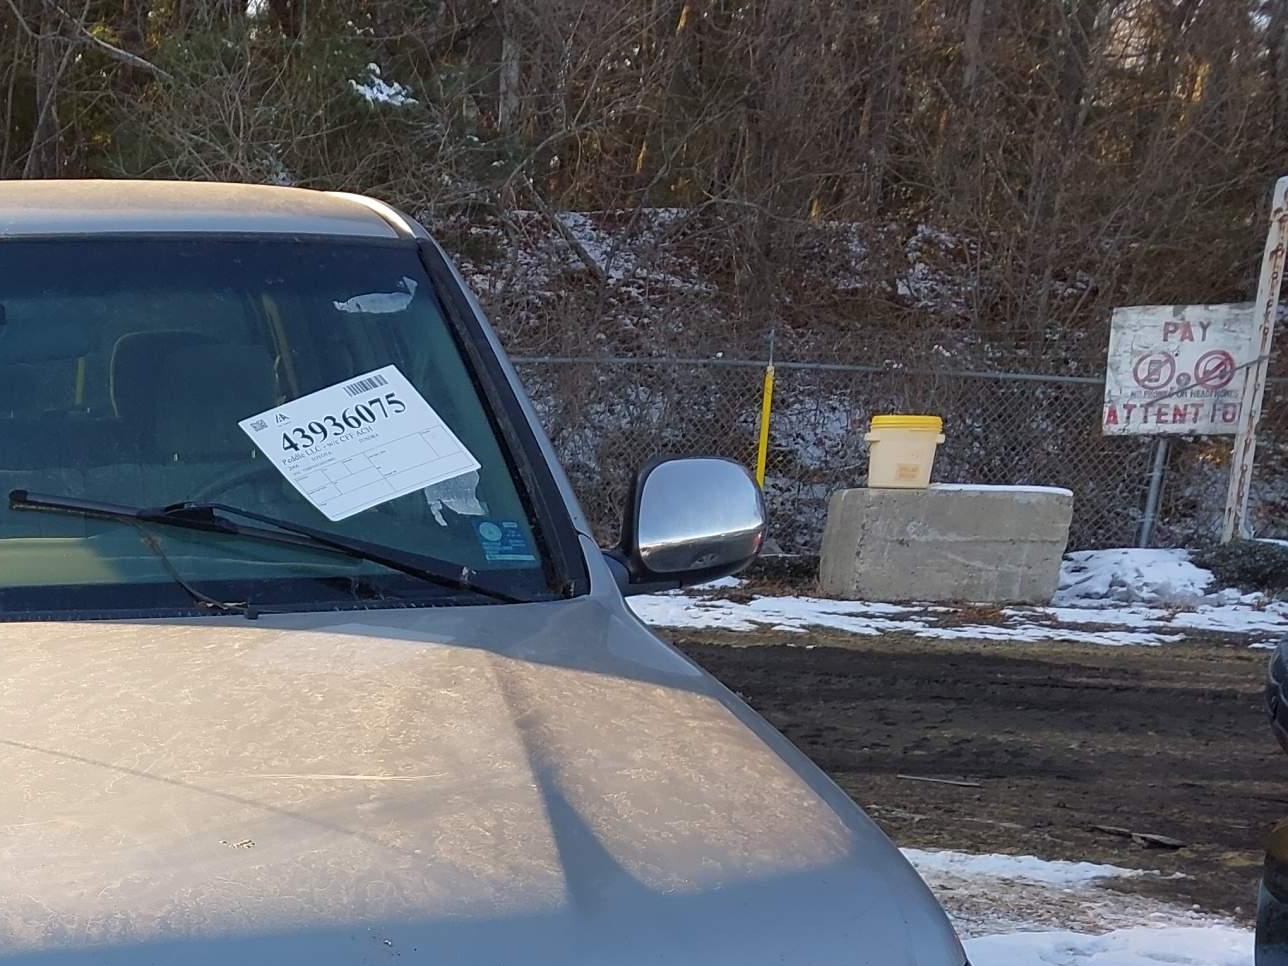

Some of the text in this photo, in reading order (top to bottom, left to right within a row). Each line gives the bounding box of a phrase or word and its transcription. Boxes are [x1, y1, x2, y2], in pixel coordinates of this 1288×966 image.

[1162, 321, 1211, 342] PAY
[282, 393, 406, 452] 43936075
[1106, 403, 1238, 425] ATTENTIO
[305, 446, 321, 457] LLC
